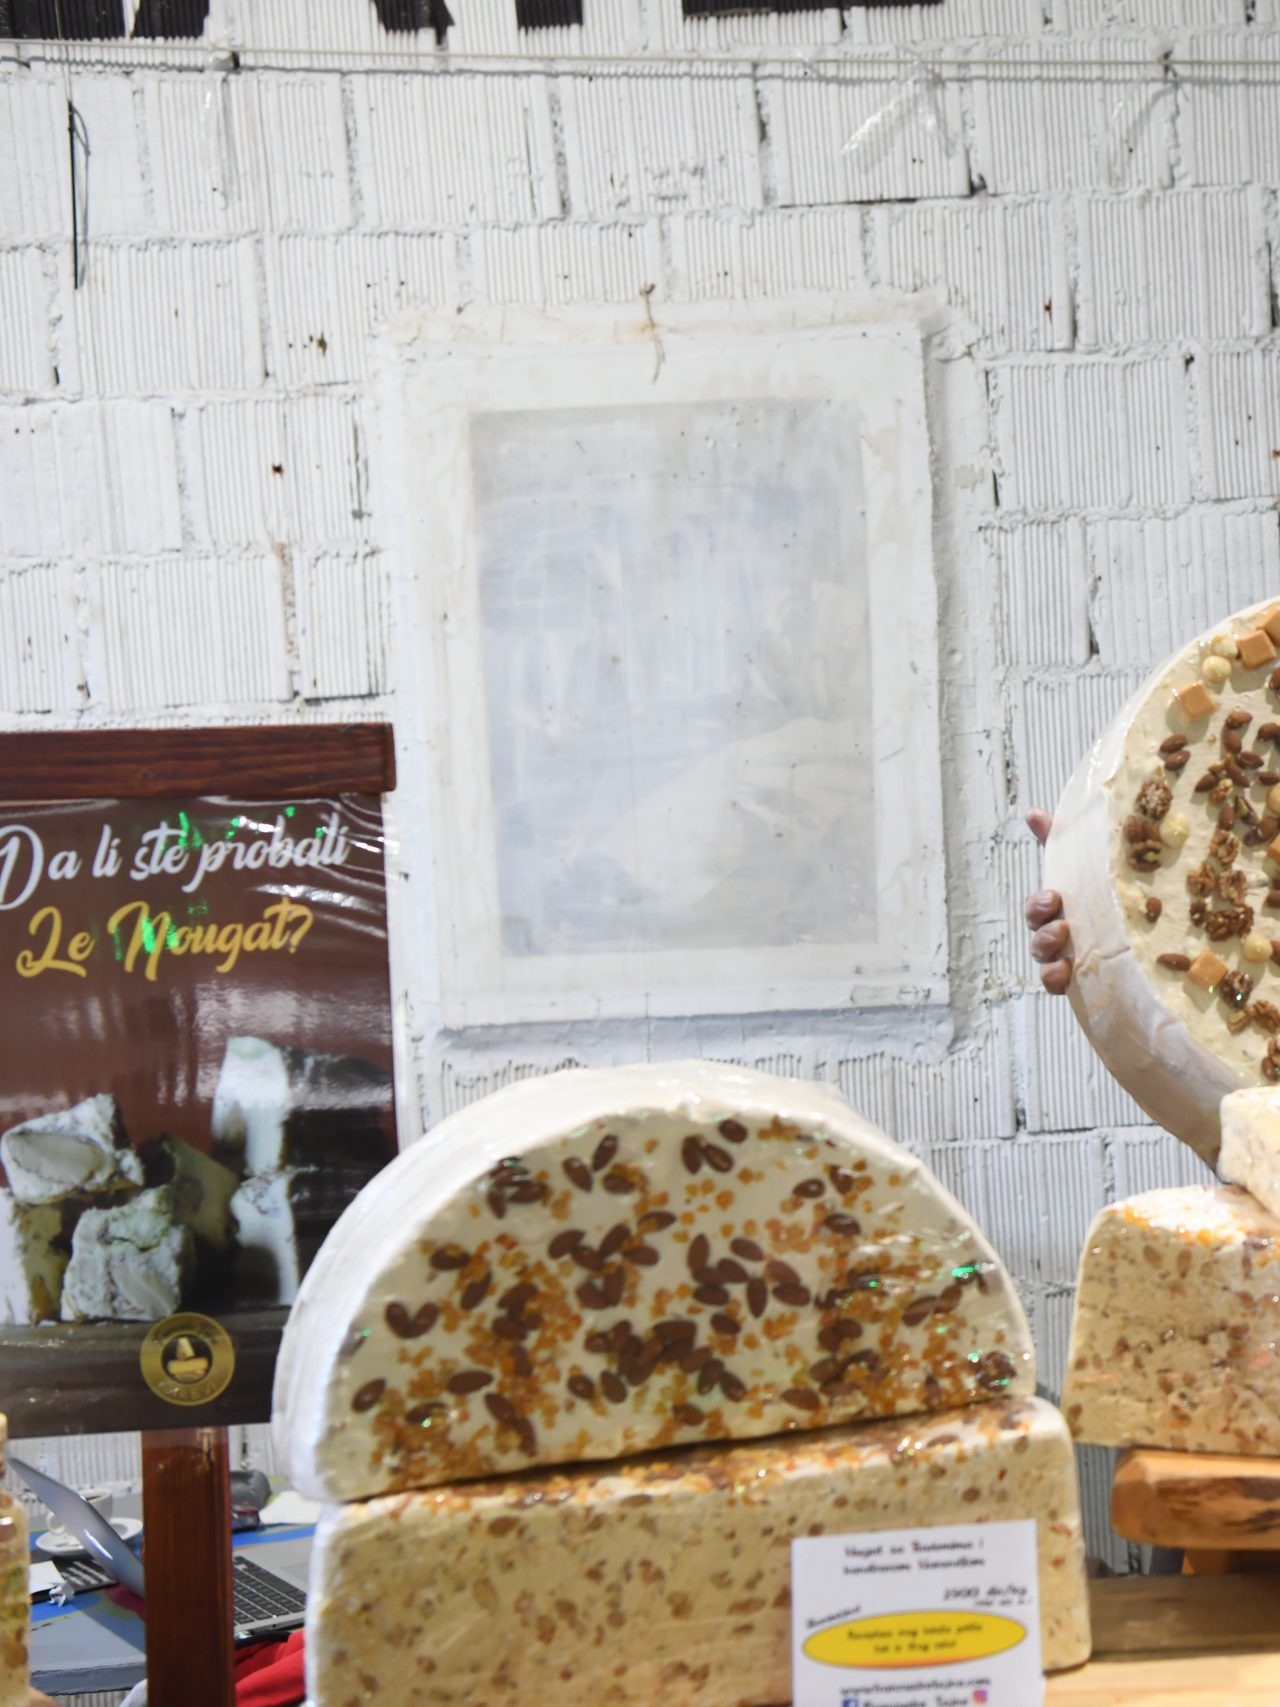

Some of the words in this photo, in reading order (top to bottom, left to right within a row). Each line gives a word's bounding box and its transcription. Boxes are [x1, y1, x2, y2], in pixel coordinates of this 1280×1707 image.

[0, 824, 81, 910] Da
[92, 824, 122, 880] li
[130, 821, 190, 880] ste
[16, 906, 95, 978] Le
[107, 898, 314, 981] Nougat?
